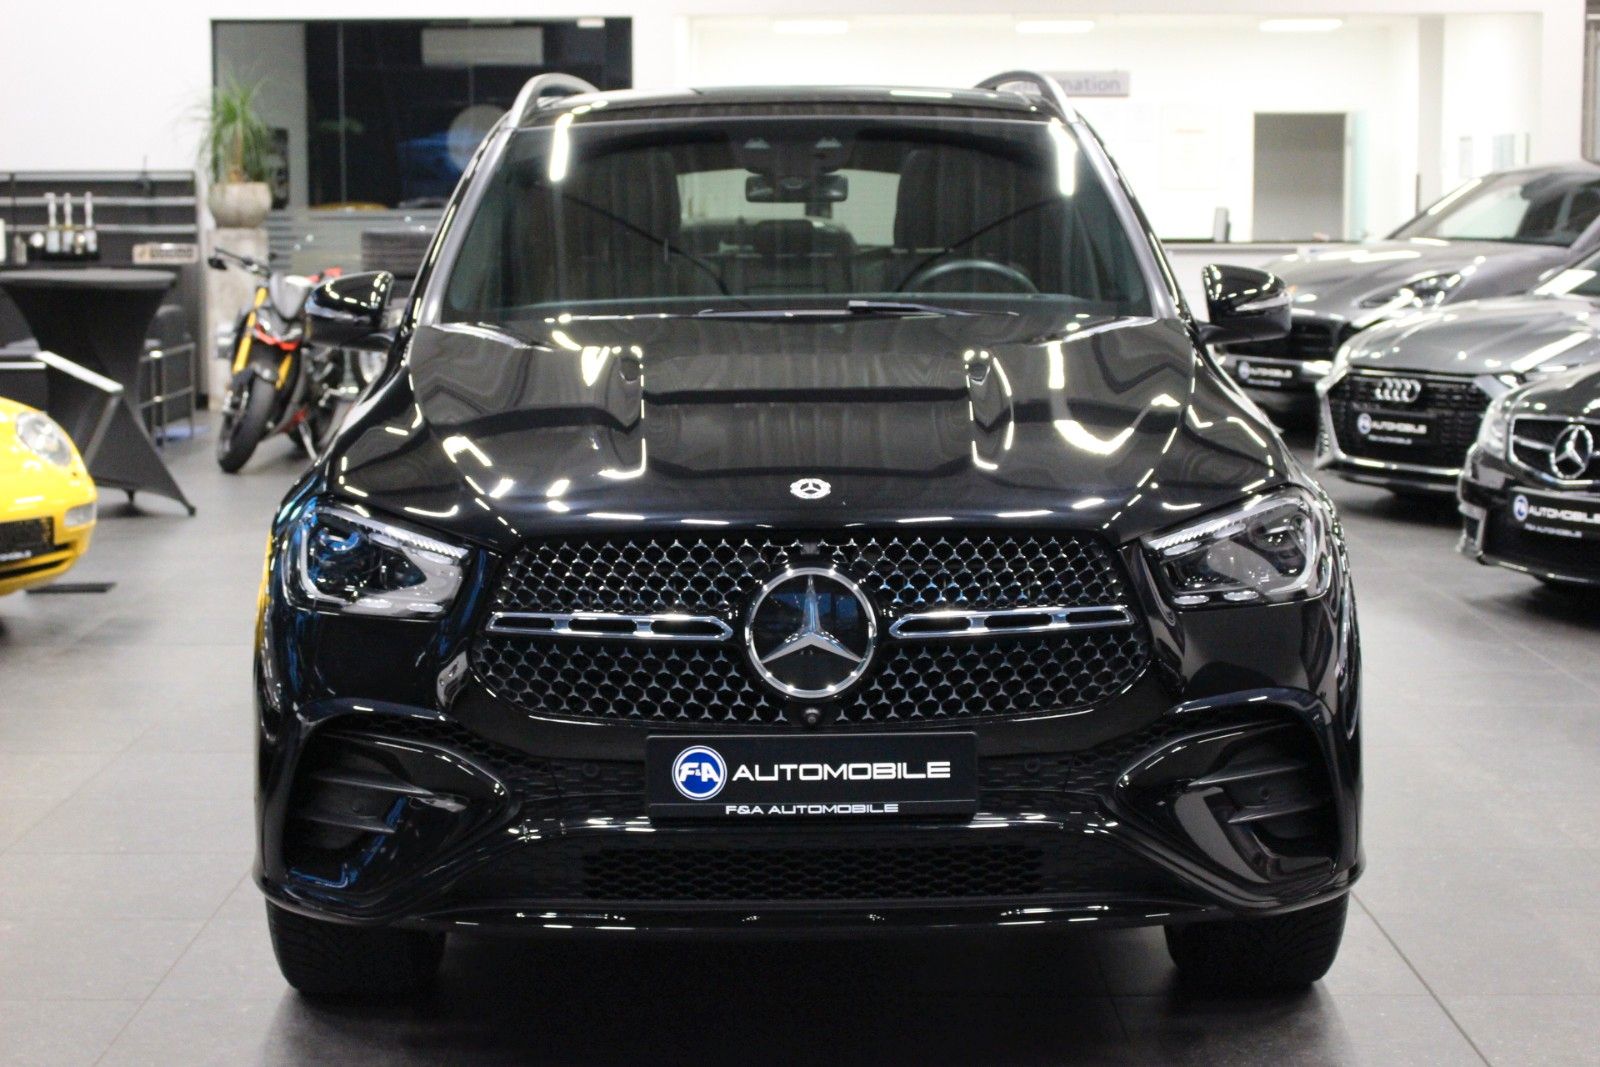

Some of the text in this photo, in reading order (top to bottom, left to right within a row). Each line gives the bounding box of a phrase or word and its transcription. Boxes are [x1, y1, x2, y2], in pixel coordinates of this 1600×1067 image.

[732, 761, 951, 782] AUTOMOBILE
[725, 803, 899, 816] F&A AUTOMOBILE
